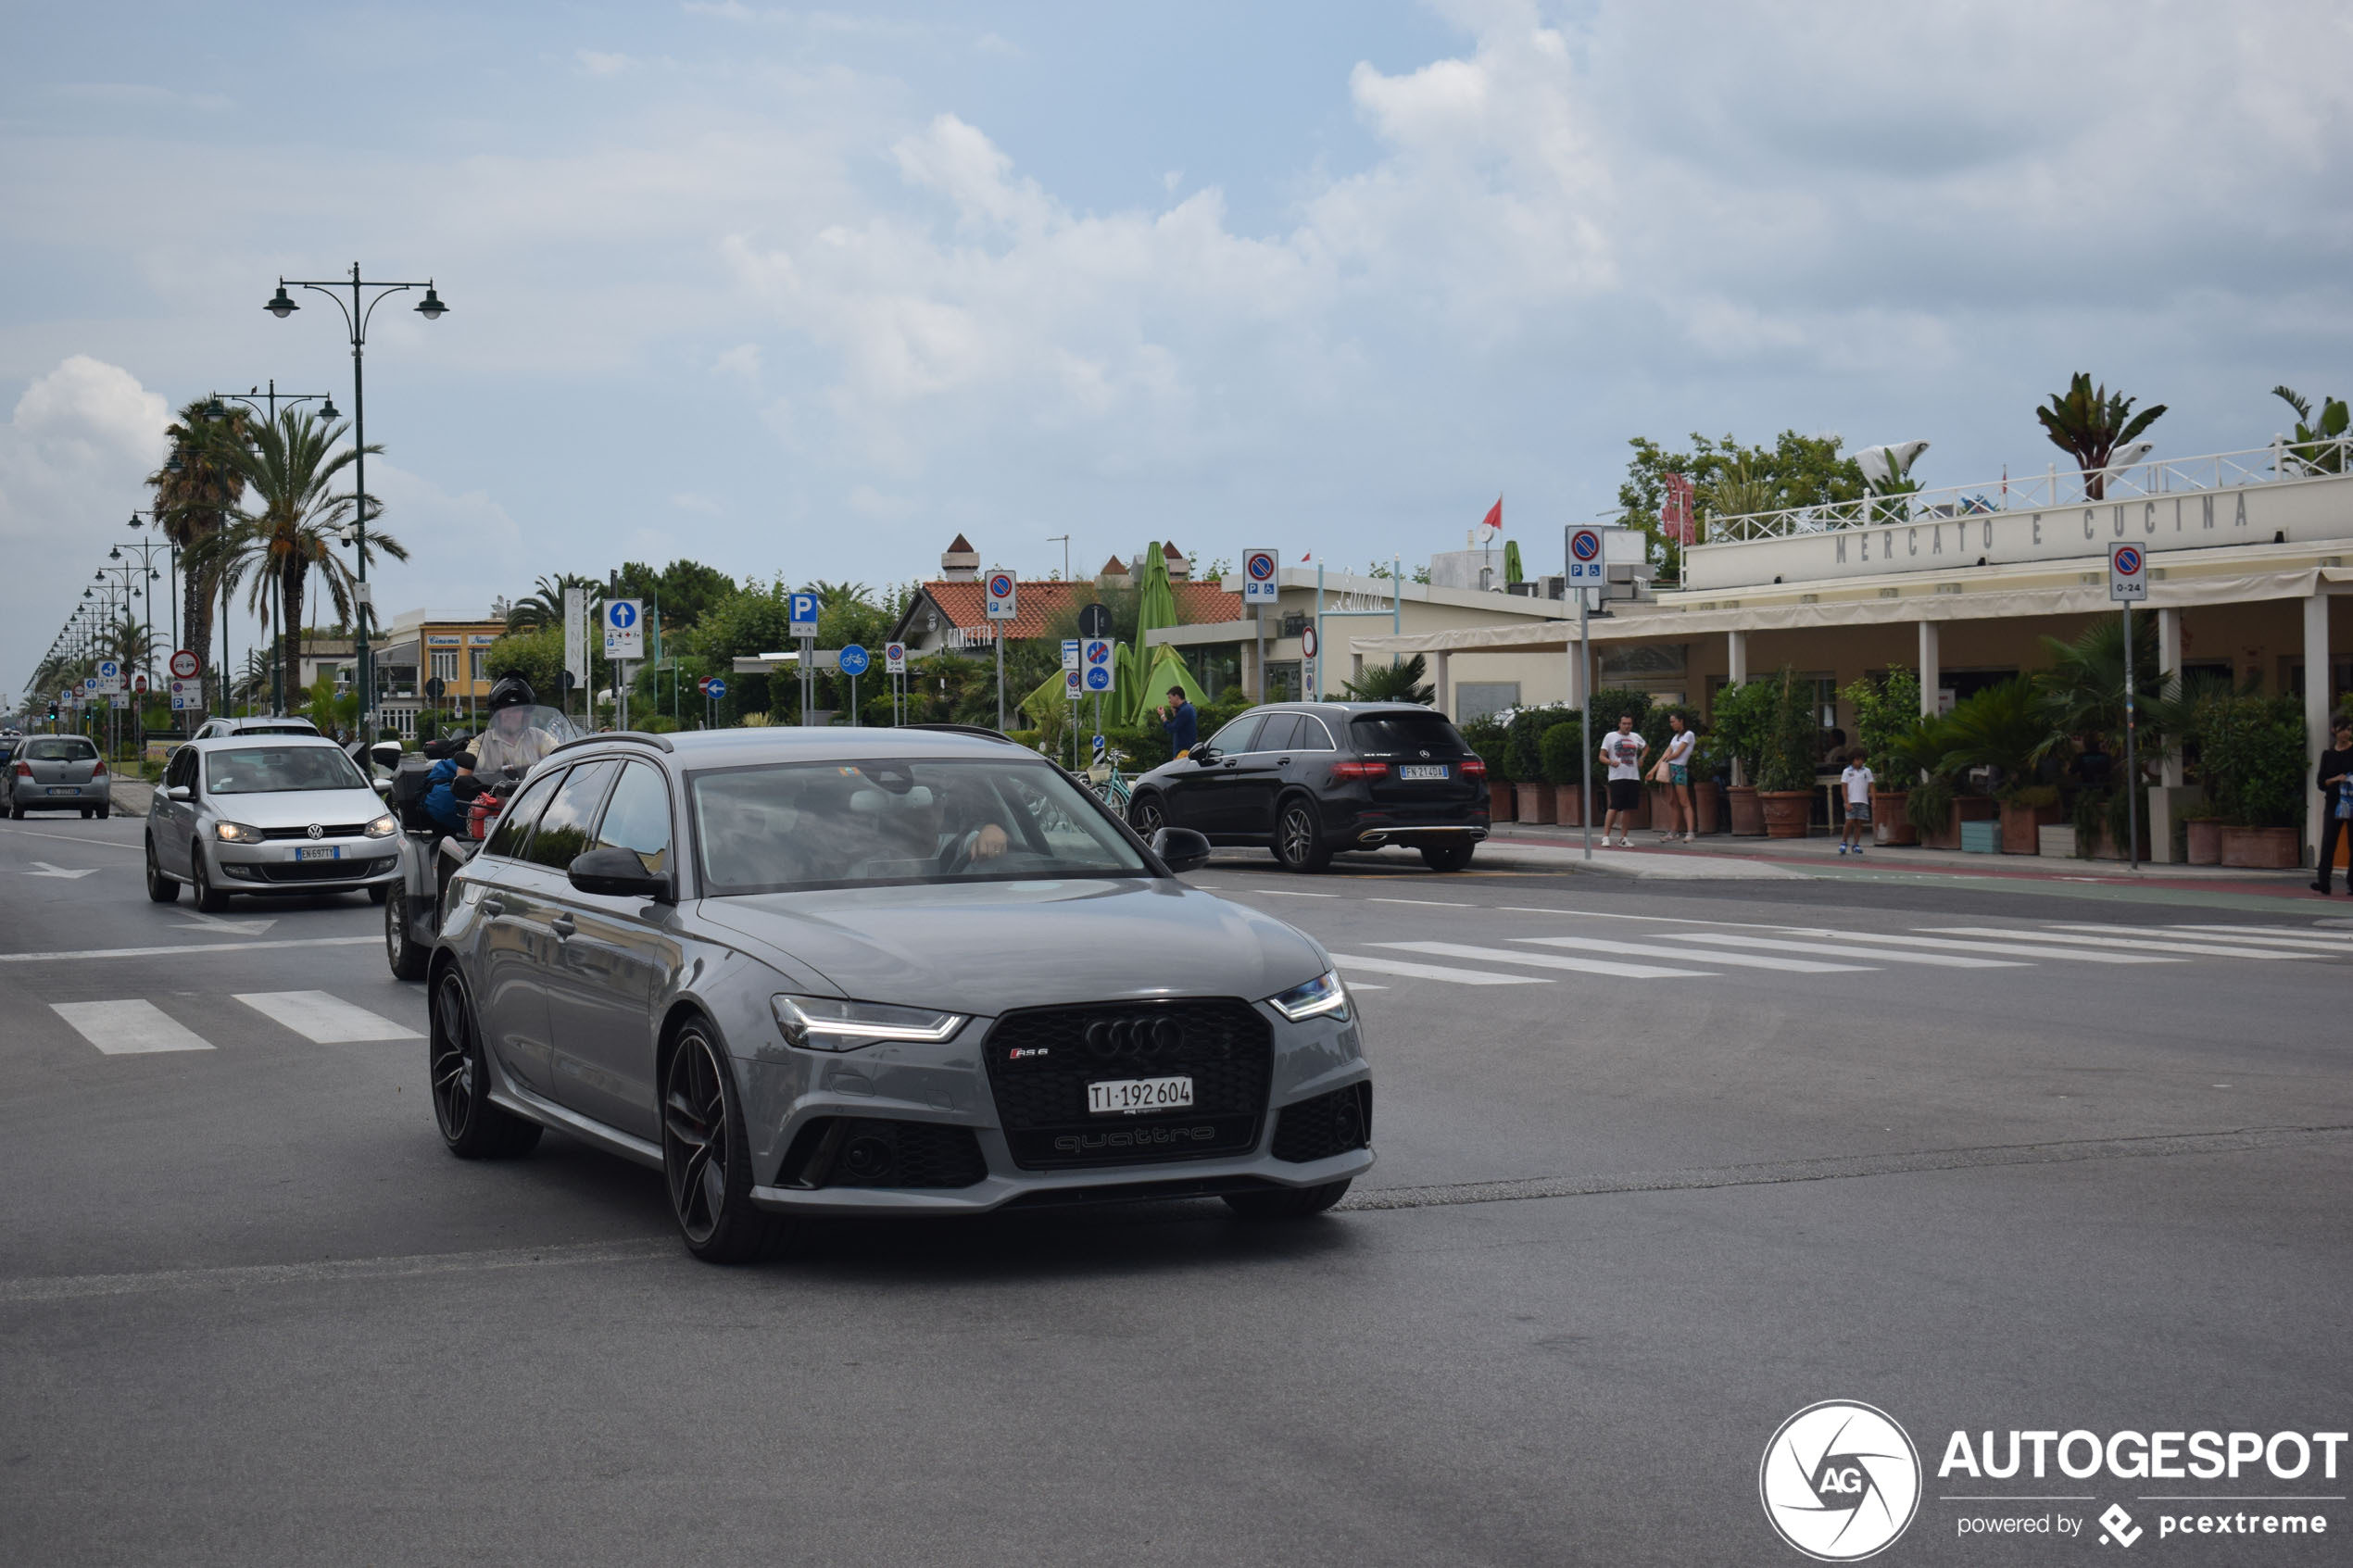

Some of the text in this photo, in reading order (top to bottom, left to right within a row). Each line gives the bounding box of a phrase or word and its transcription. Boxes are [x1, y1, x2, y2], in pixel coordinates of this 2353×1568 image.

[1836, 492, 2247, 564] MERCATO E CUCINA
[2117, 583, 2141, 592] 0-24
[795, 596, 812, 620] P
[948, 624, 992, 648] CONCETTA
[1054, 1126, 1215, 1153] quattro
